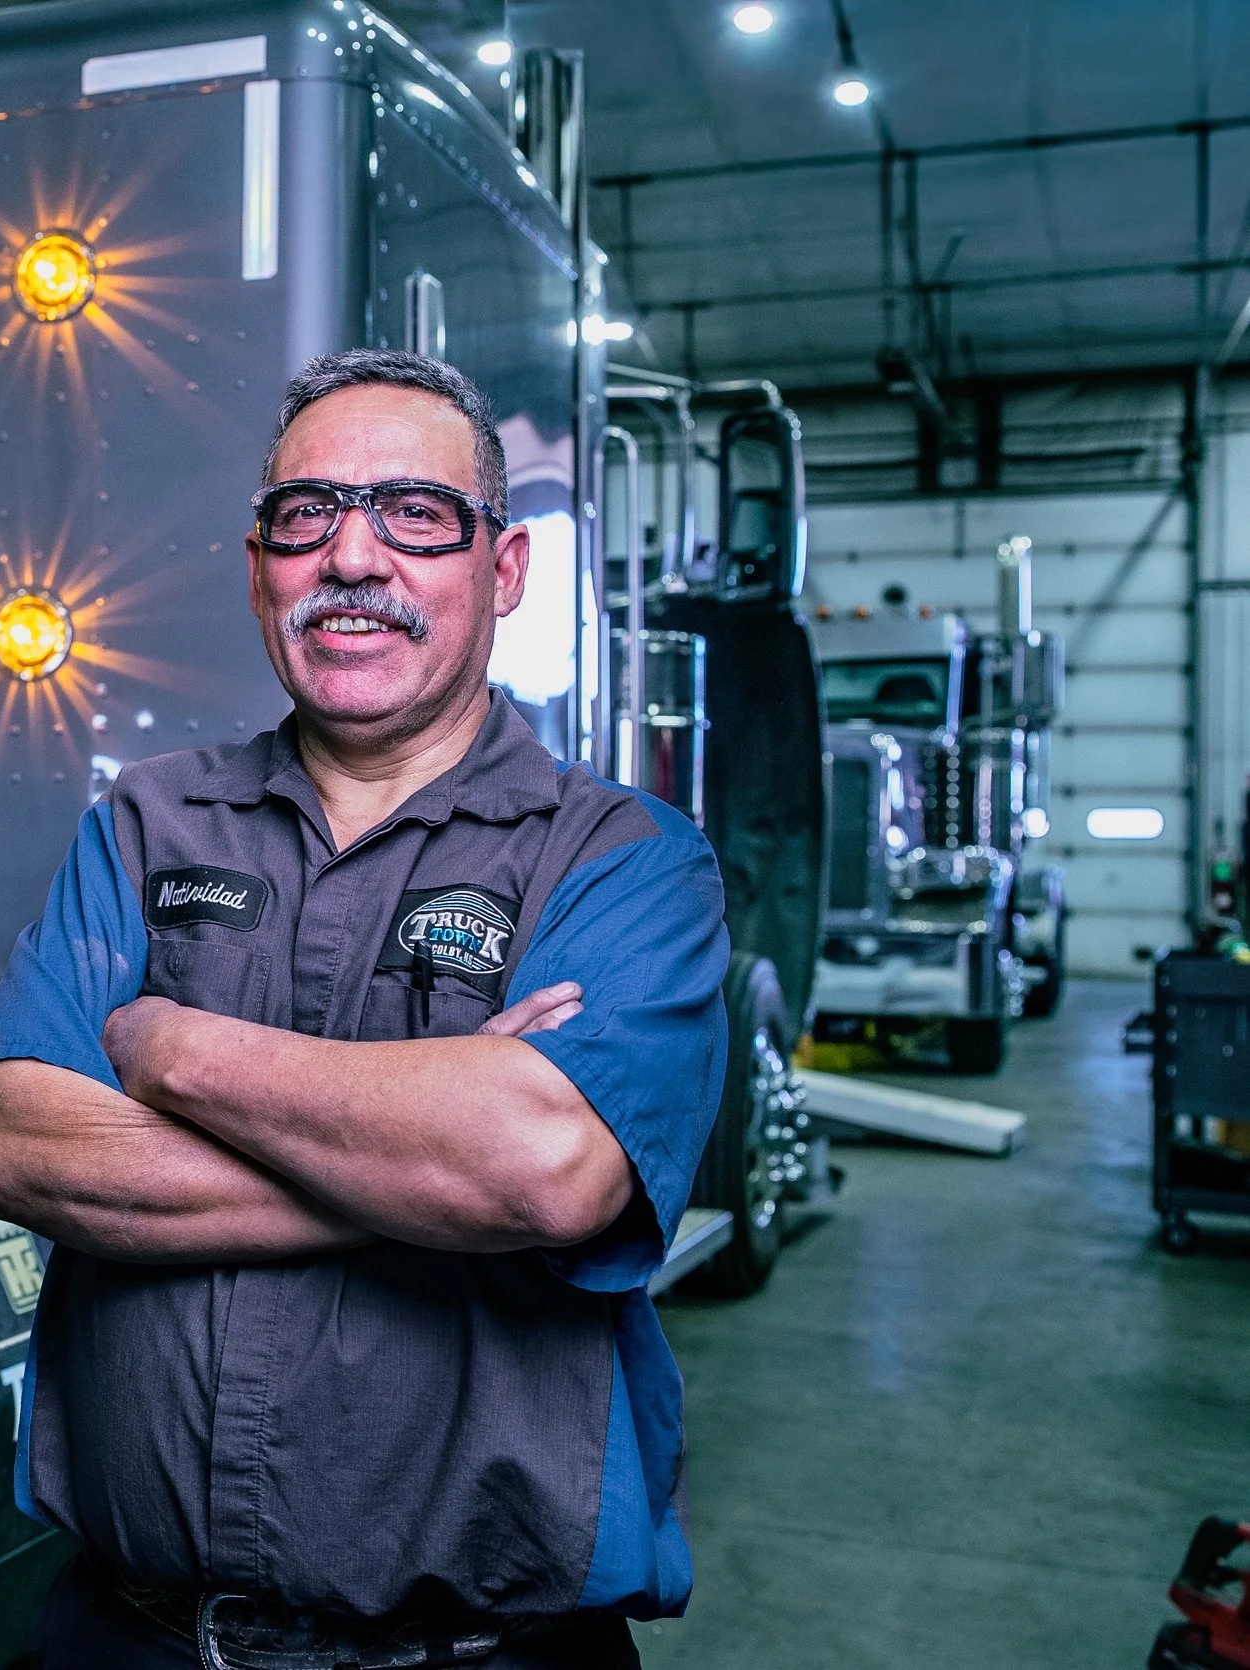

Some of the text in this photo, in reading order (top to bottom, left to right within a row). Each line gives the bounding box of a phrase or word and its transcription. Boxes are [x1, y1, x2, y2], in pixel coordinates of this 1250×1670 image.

[157, 881, 249, 910] Natividad
[408, 911, 509, 964] TRUCK
[430, 927, 482, 953] TOWN
